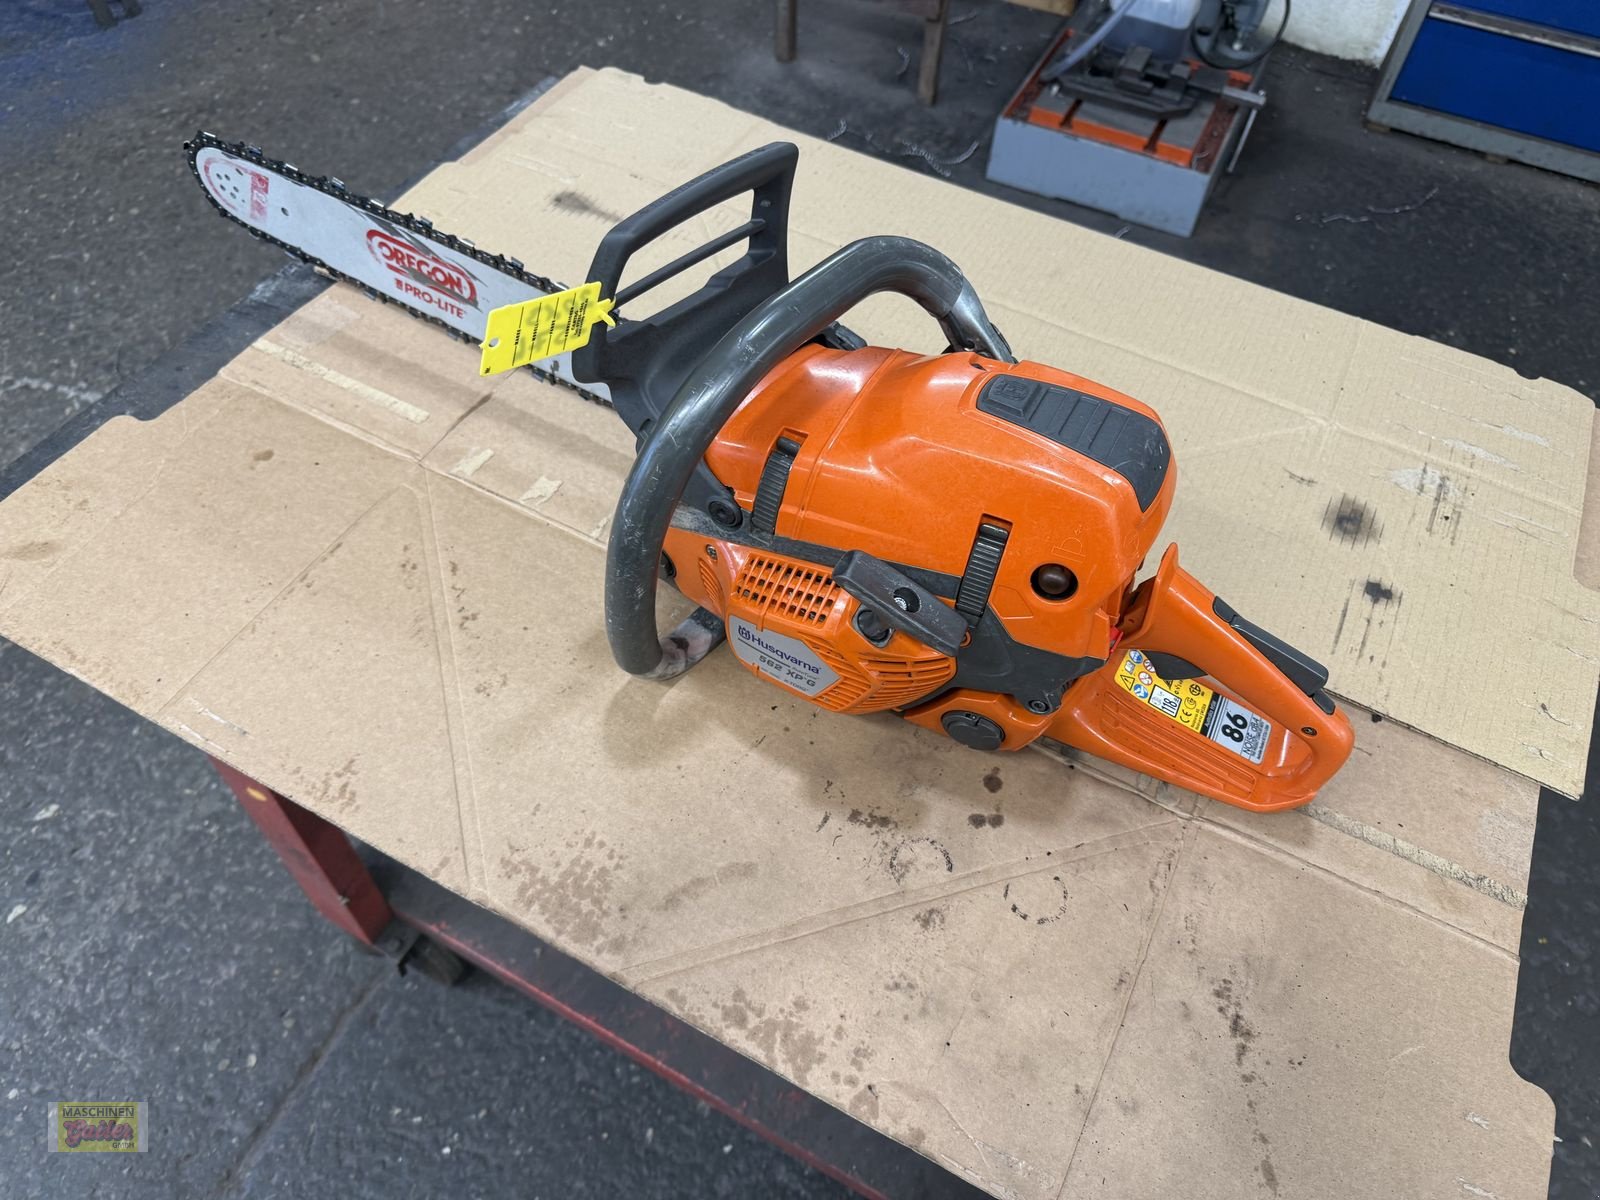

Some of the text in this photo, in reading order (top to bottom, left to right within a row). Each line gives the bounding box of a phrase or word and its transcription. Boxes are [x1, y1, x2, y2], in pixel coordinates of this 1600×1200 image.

[378, 242, 464, 294] OREGON
[405, 284, 464, 319] PRO-LITE
[752, 634, 820, 674] Husqvarna
[759, 655, 783, 672] 562
[1161, 697, 1176, 715] 118
[1220, 711, 1248, 743] 86
[1243, 731, 1255, 755] NOISE
